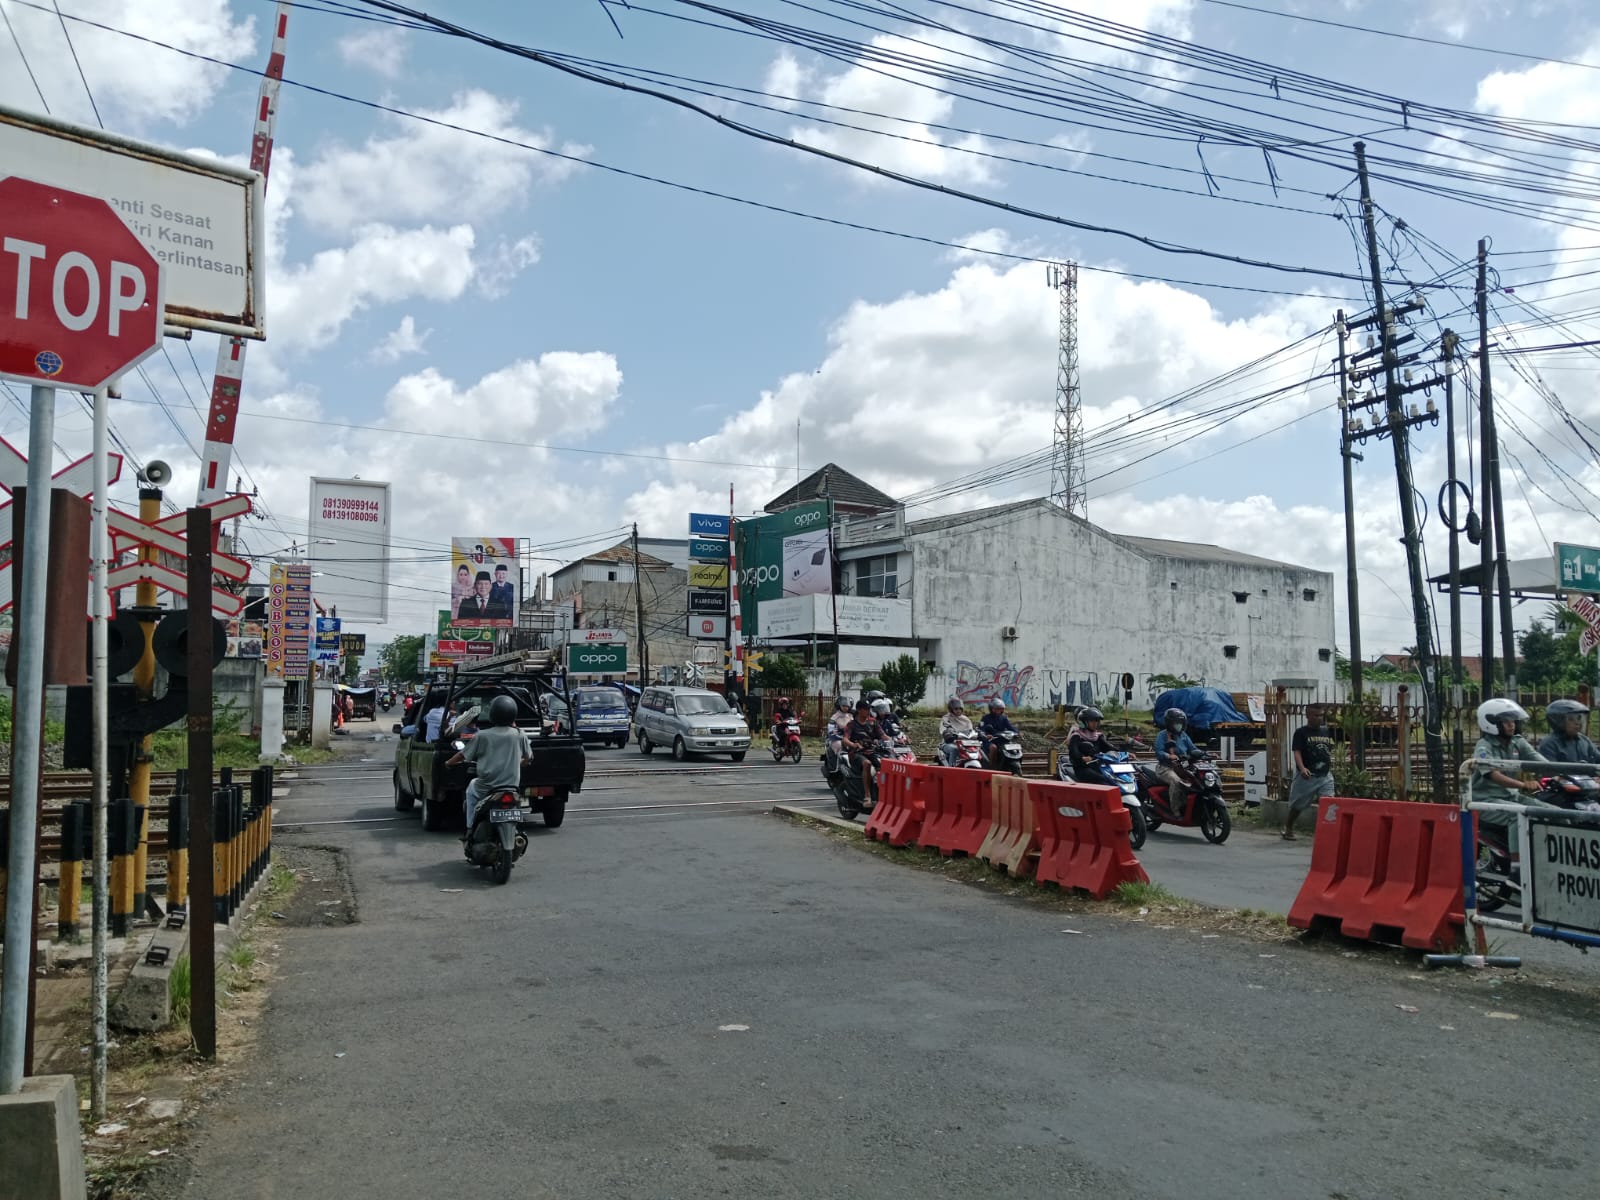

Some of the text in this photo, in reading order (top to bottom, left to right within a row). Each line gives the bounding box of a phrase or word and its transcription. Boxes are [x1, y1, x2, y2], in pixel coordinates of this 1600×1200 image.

[150, 203, 212, 230] Sesaat
[158, 226, 214, 250] Kanan
[151, 245, 244, 277] erlintasan
[3, 236, 147, 338] TOP
[323, 498, 379, 511] 081390999144
[323, 509, 378, 522] 081391080096
[698, 520, 722, 528] vivo
[795, 511, 820, 526] oppo
[1572, 597, 1600, 623] AWAS
[580, 654, 617, 665] oppo
[1249, 764, 1256, 776] 3
[1547, 833, 1600, 870] DINAS
